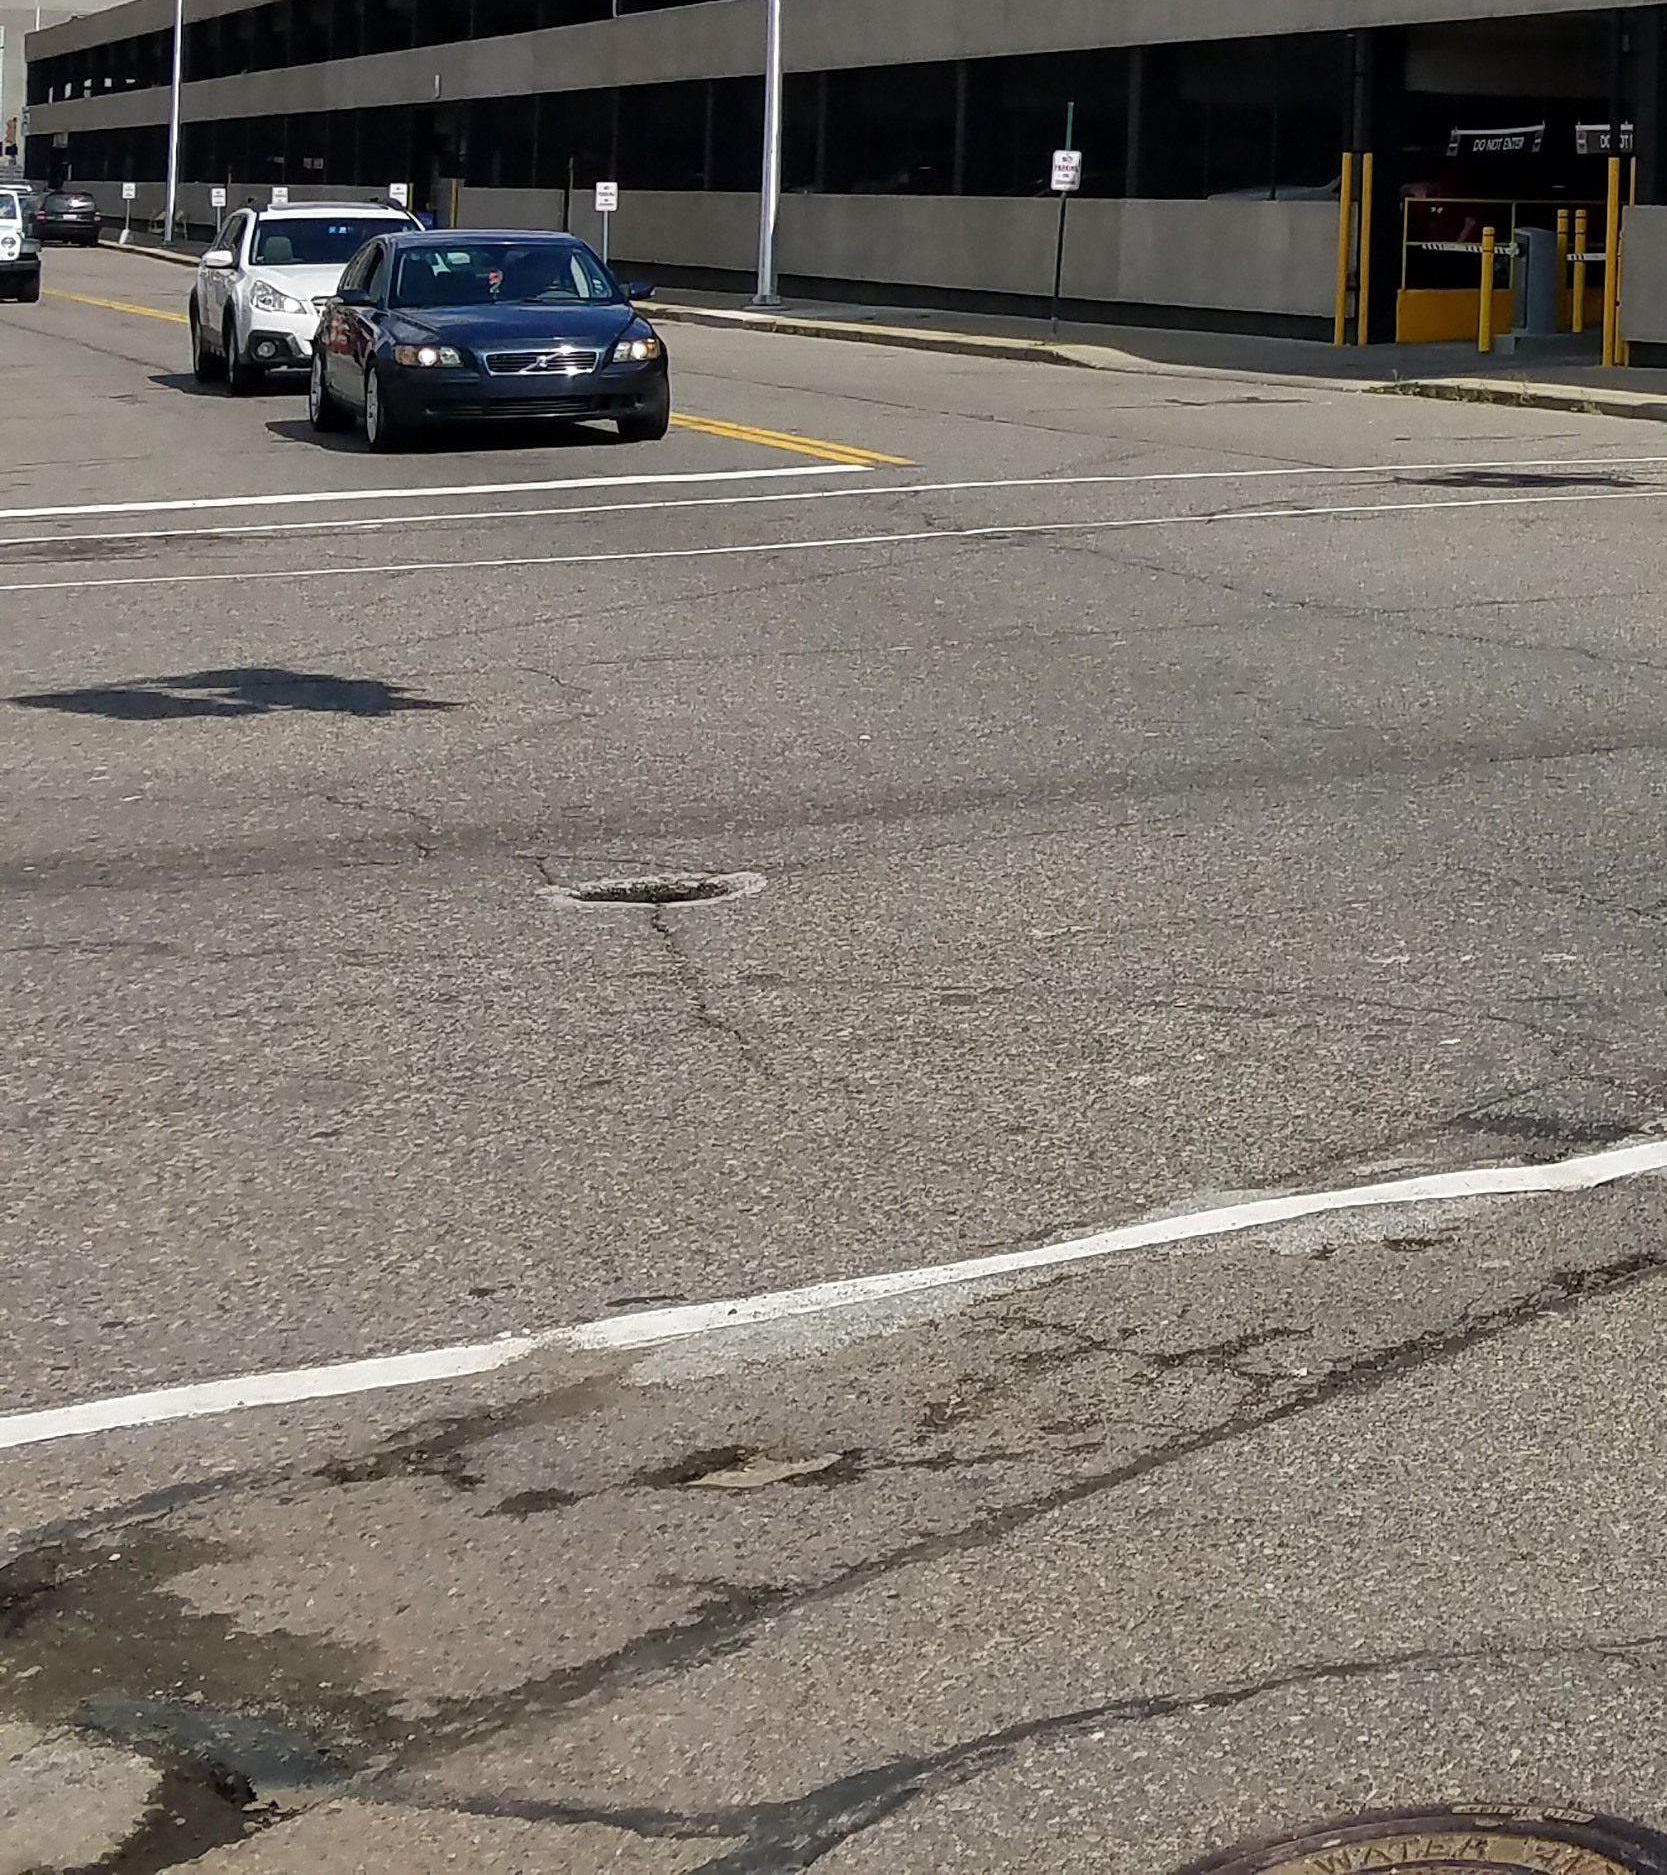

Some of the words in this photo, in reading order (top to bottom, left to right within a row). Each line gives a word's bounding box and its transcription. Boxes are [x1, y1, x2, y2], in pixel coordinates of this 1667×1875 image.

[1473, 138, 1486, 152] DO
[1486, 137, 1502, 151] NOT
[1502, 136, 1525, 150] ENTER
